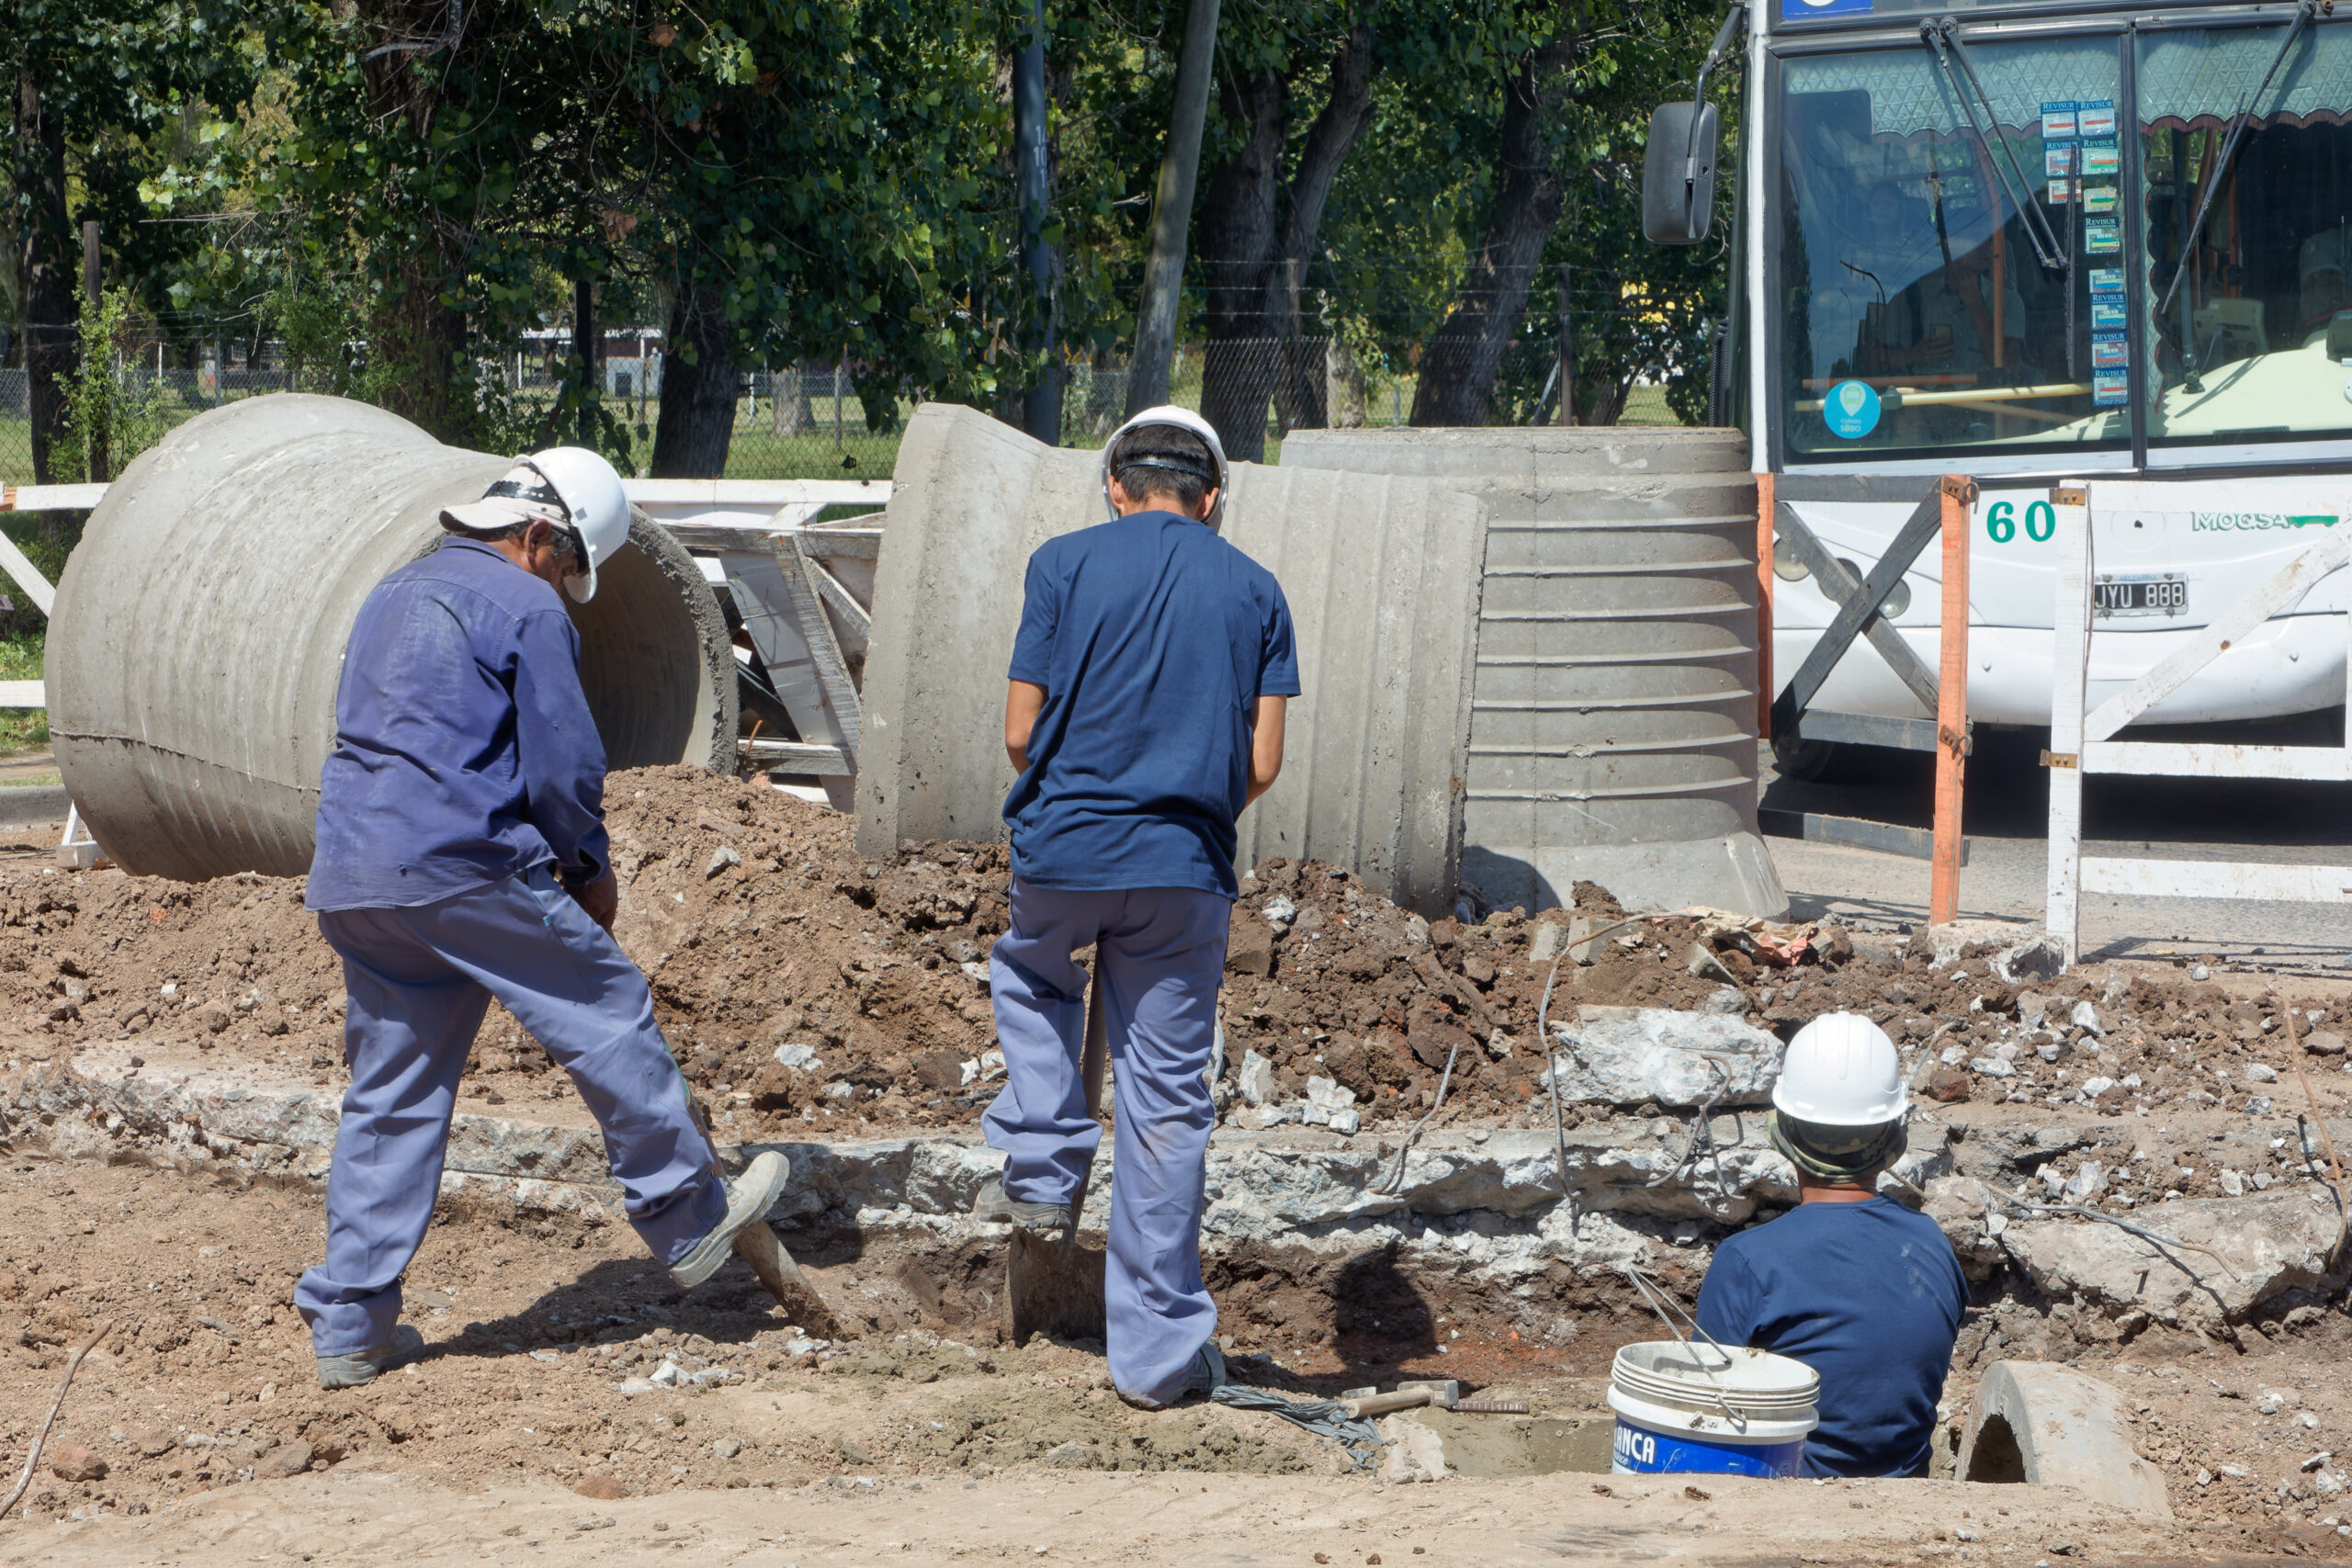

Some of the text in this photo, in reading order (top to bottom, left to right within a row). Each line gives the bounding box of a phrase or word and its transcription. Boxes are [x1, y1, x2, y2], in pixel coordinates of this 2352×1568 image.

[2042, 102, 2075, 110] REVISUR
[2080, 101, 2113, 109] REVISUR
[2083, 139, 2115, 147] REVISUR
[2086, 218, 2117, 226] REVISUR
[2093, 333, 2125, 341] REVISUR
[2095, 369, 2127, 378] REVISUR
[1986, 500, 2056, 544] 60
[2095, 582, 2184, 609] JYU 888
